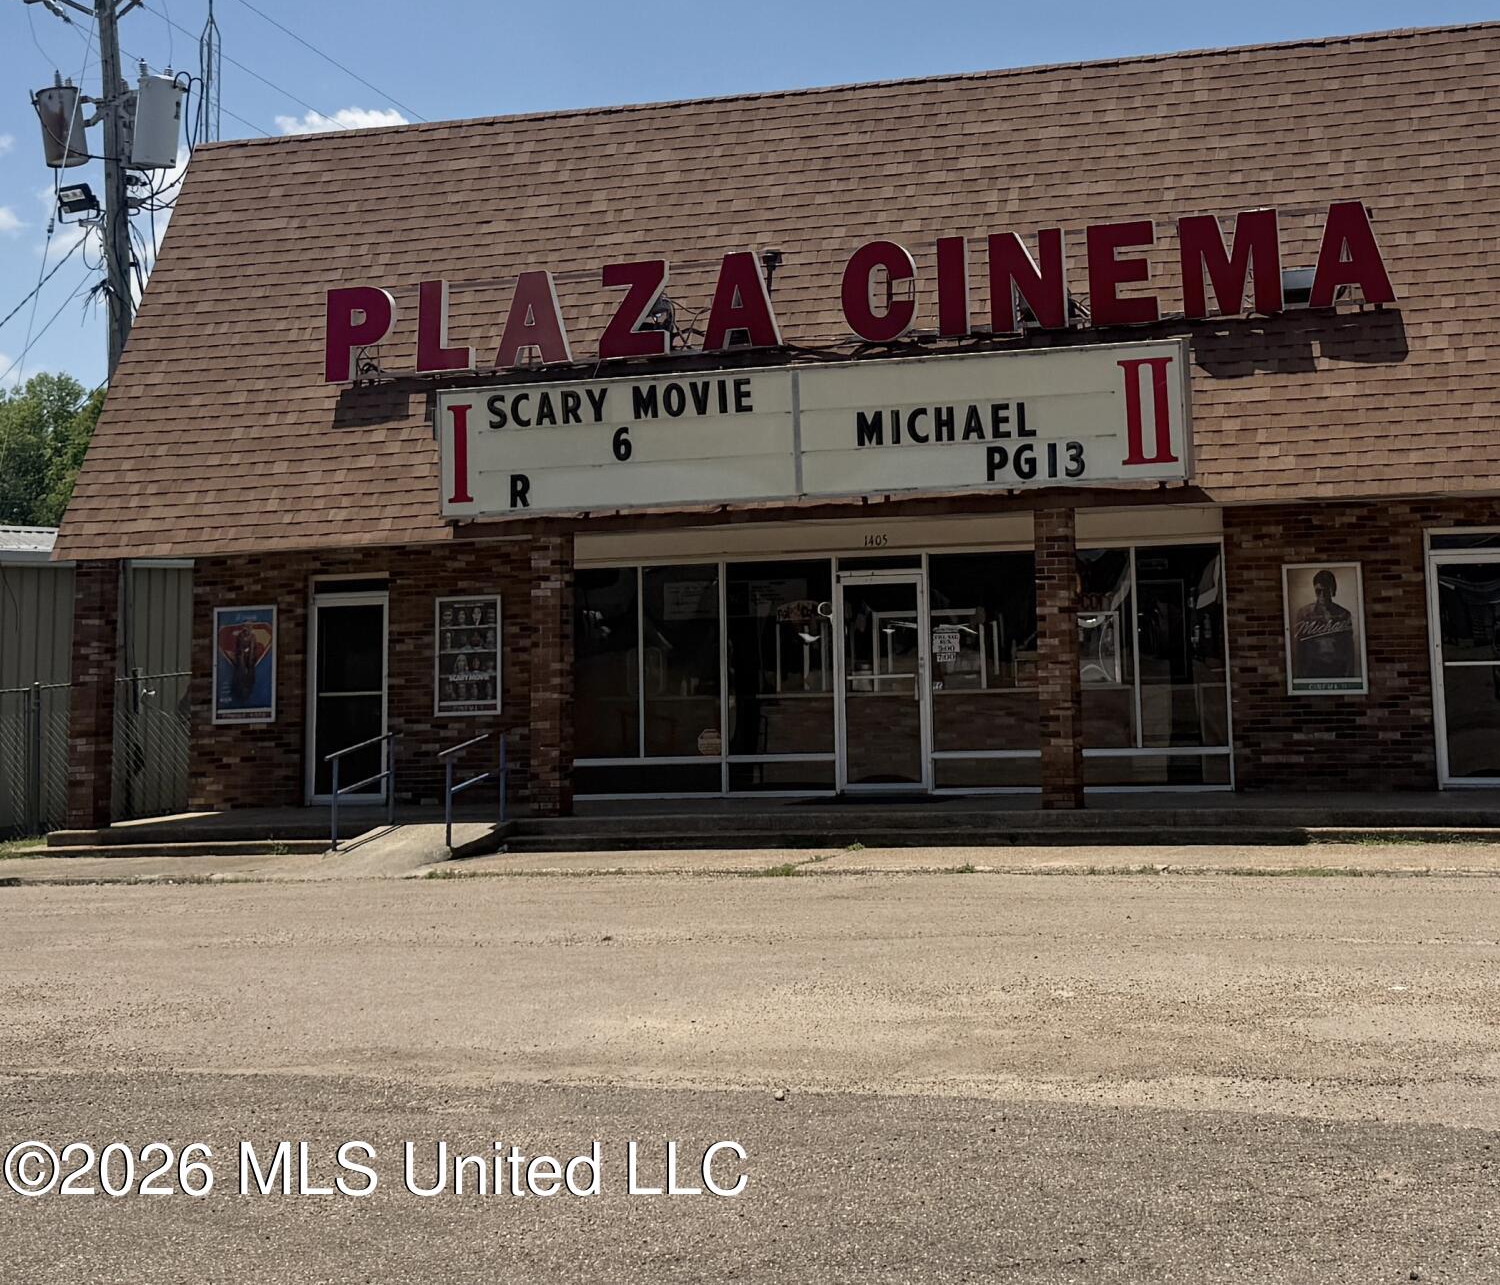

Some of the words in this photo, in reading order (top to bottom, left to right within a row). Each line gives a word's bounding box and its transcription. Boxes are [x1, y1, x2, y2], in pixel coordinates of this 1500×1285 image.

[325, 251, 784, 383] PLAZA
[841, 201, 1396, 343] CINEMA
[486, 387, 609, 430] SCARY
[632, 377, 754, 420] MOVIE
[856, 401, 1038, 447] MICHAEL
[611, 426, 633, 462] 6
[986, 441, 1086, 482] PG13
[509, 473, 531, 509] R
[864, 534, 888, 547] 1405
